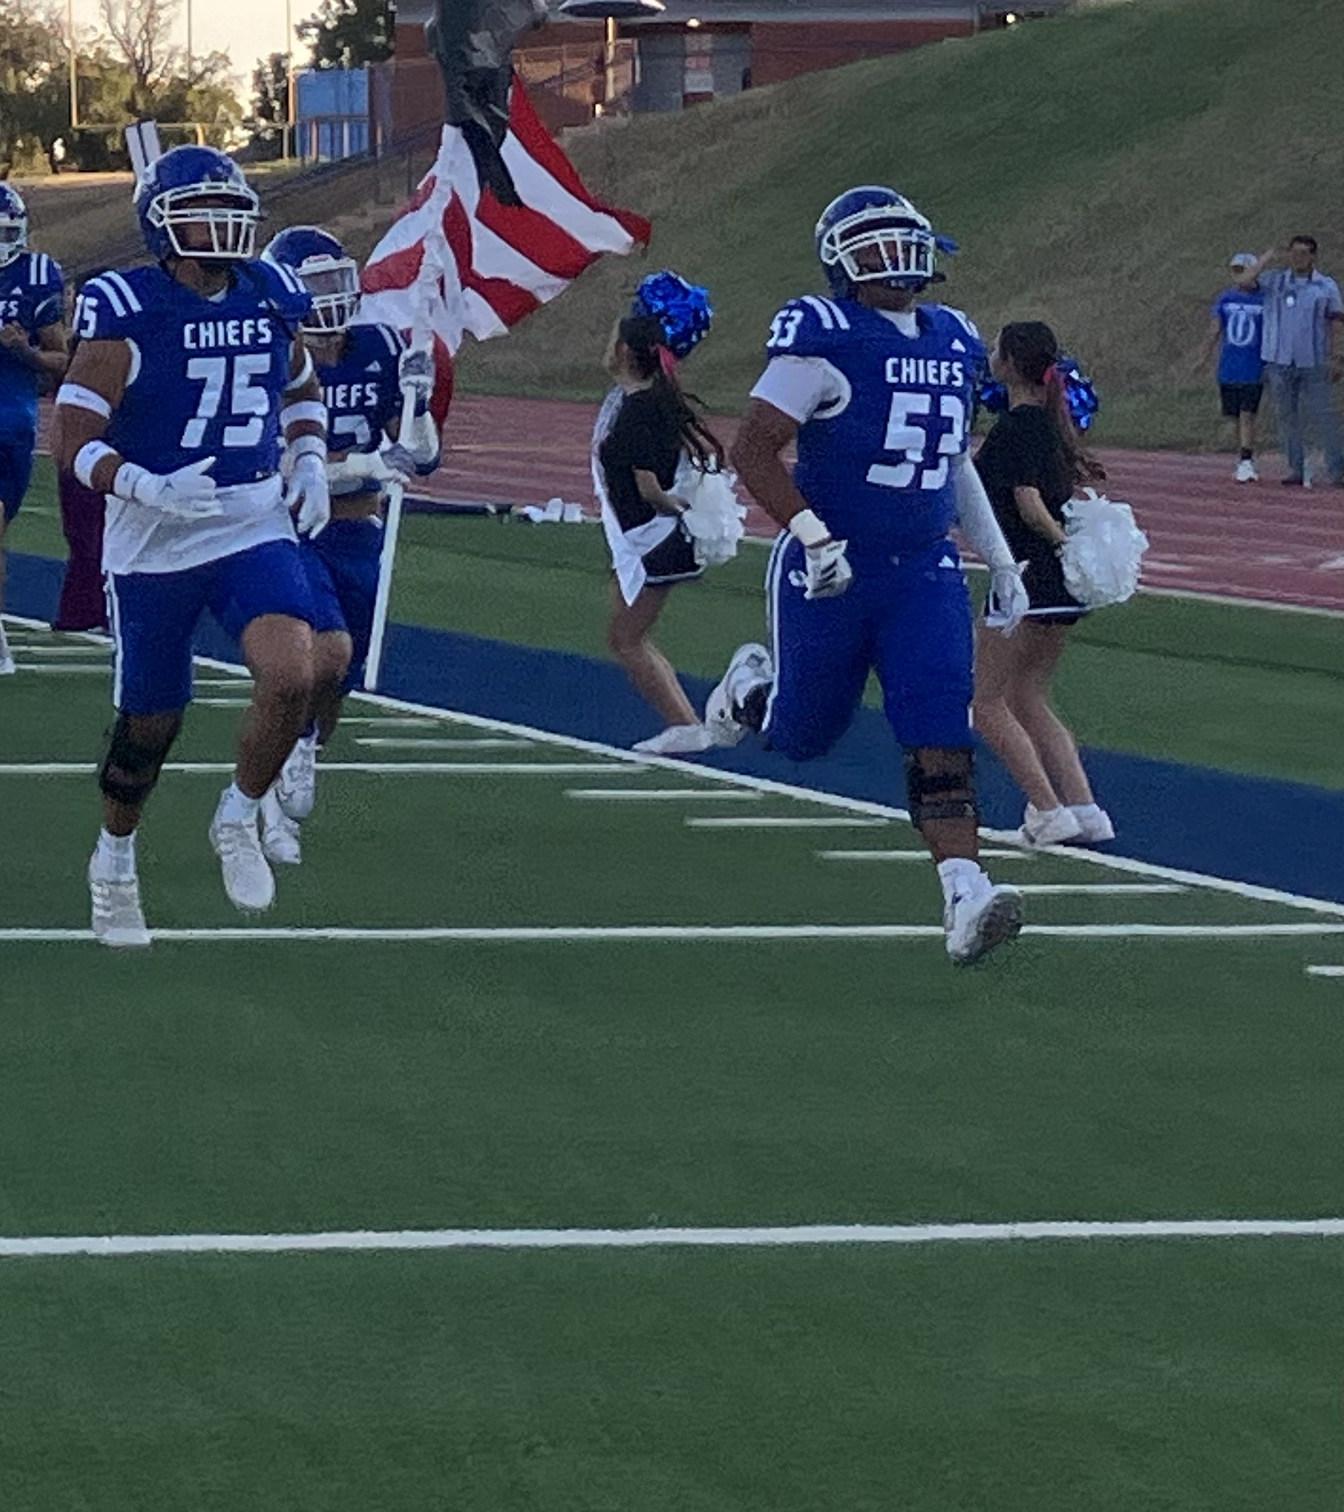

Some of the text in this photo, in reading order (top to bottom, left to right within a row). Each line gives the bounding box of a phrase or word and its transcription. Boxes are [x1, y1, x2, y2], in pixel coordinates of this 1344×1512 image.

[183, 318, 272, 350] CHIEFS
[885, 357, 964, 388] CHIEFS
[180, 352, 272, 449] 75
[326, 382, 379, 409] IEFS
[866, 391, 965, 491] 53
